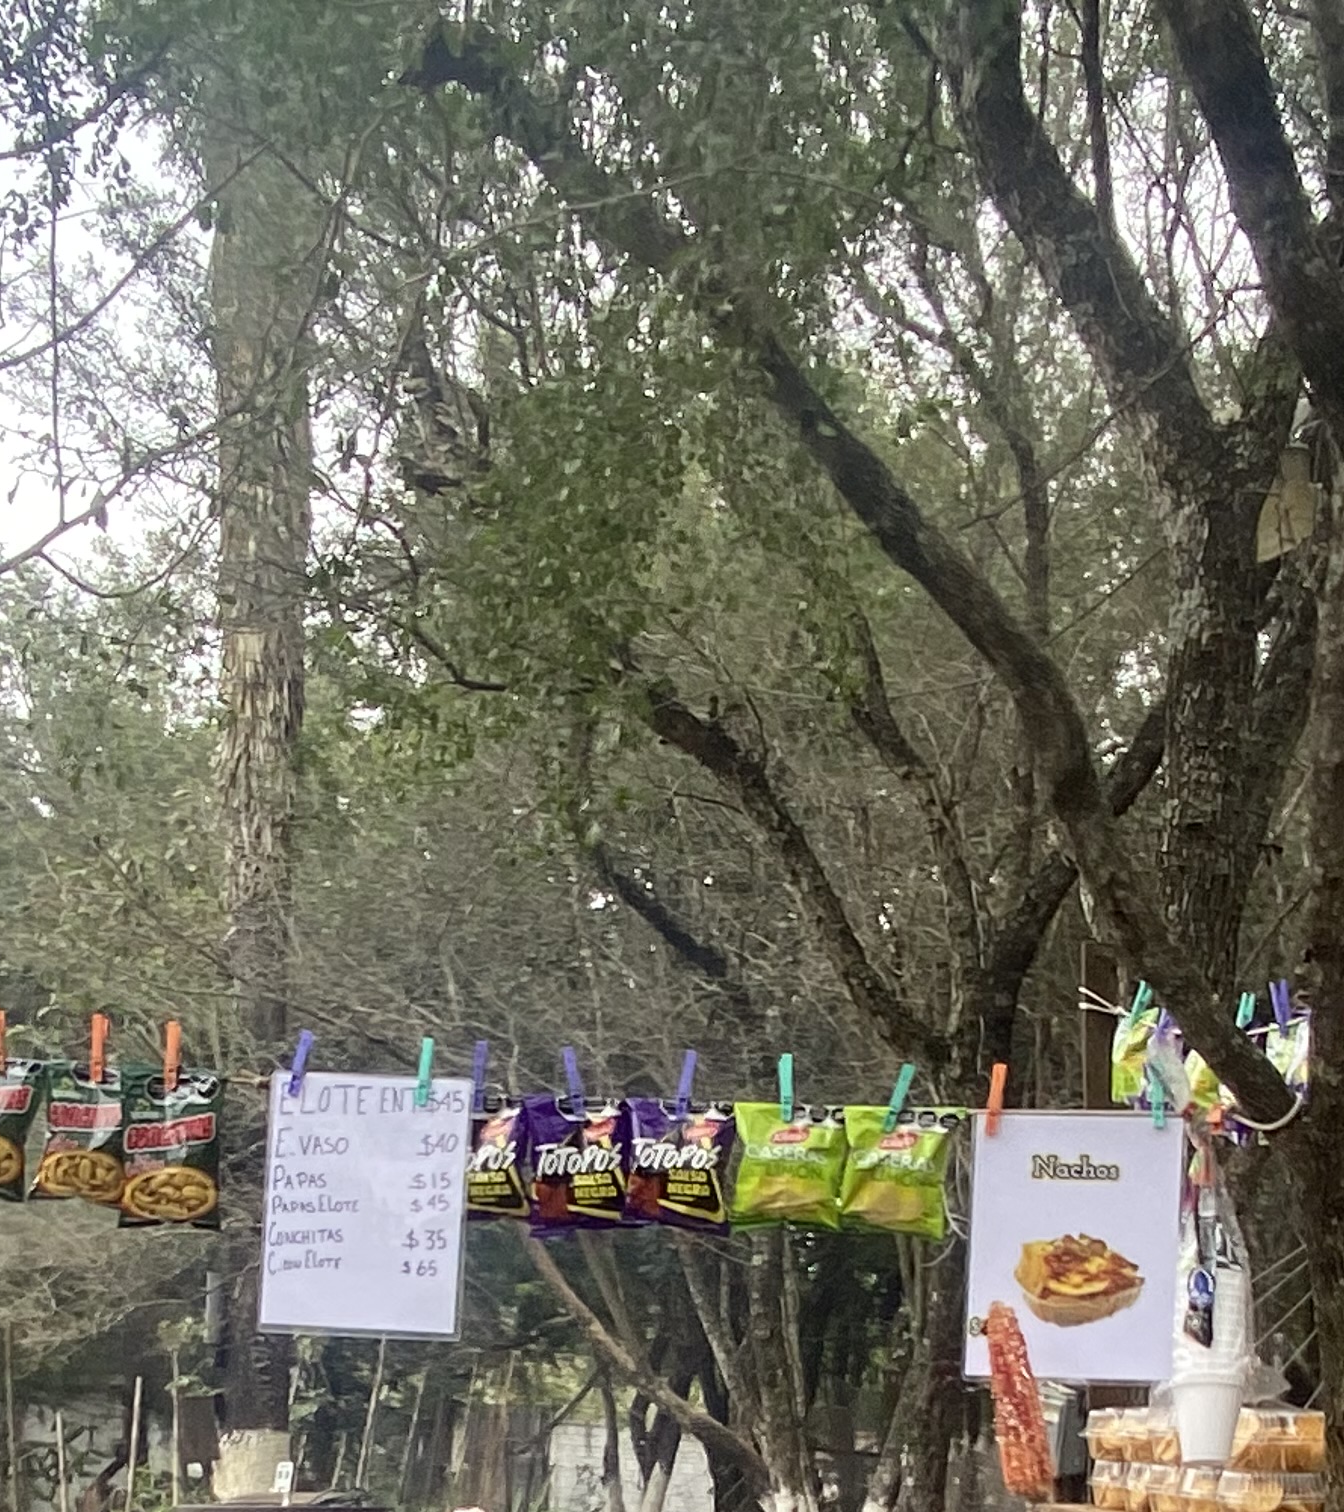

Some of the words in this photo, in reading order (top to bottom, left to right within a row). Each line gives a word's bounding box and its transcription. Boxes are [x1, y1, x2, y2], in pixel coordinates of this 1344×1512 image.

[279, 1081, 372, 1115] ELOTE
[299, 1134, 350, 1156] VASO
[632, 1137, 723, 1174] TOTOPOS
[535, 1142, 623, 1180] TOTOPOS
[1031, 1154, 1121, 1181] Nachos
[272, 1165, 328, 1191] PAPAS
[268, 1221, 345, 1247] CONCHITAS
